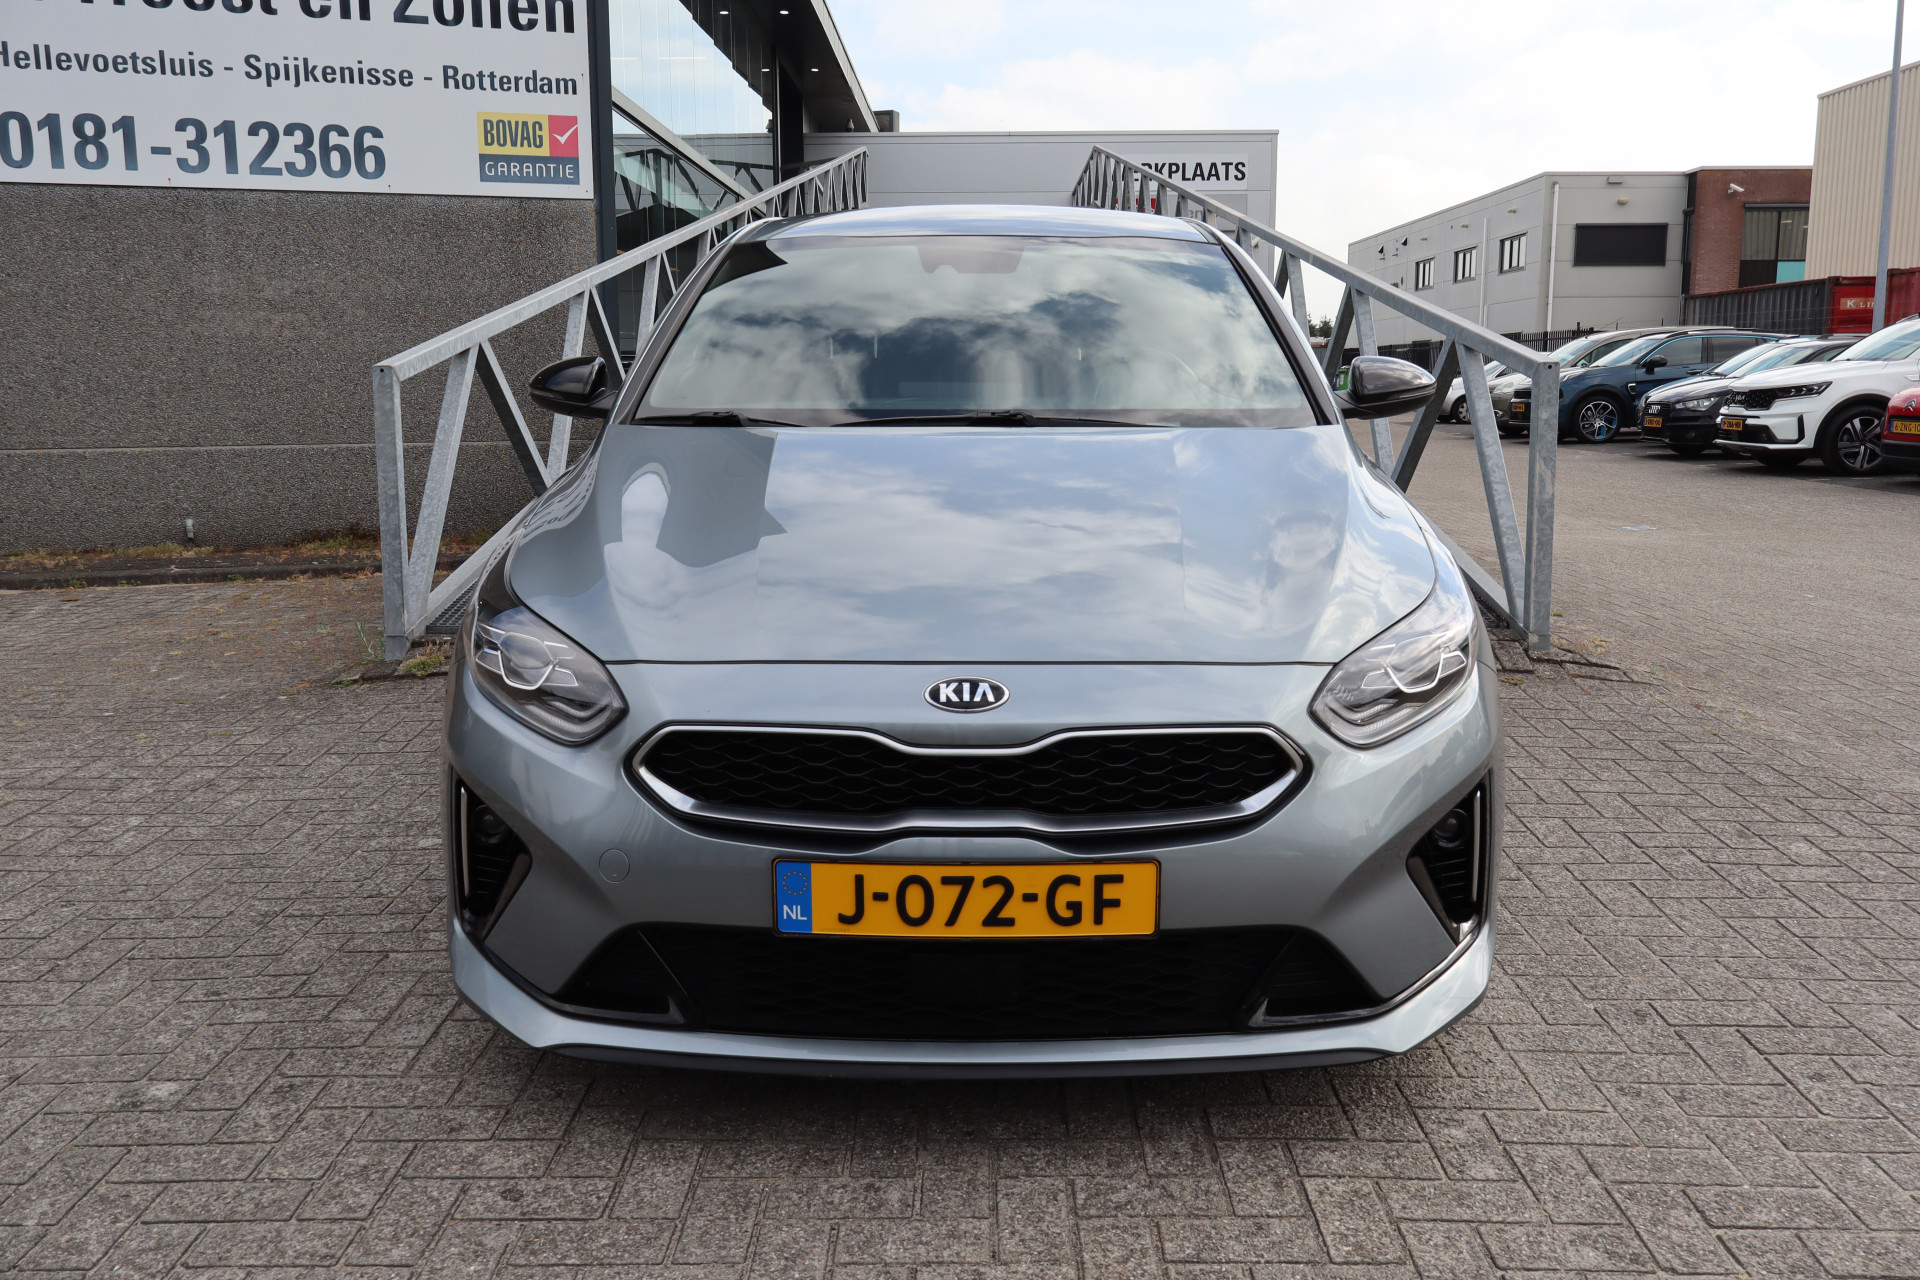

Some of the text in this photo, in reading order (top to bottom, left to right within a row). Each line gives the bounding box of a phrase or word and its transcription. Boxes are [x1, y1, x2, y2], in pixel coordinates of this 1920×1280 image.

[244, 54, 414, 88] Spijkenisse
[442, 64, 578, 95] Rotterdam
[0, 111, 387, 180] 0181-312366
[482, 118, 544, 149] BOVAG
[485, 161, 575, 179] GARANTIE
[1112, 161, 1247, 181] KPLAATS
[939, 682, 996, 703] KIA
[783, 904, 808, 920] NL
[838, 873, 1125, 928] J-072-GF
